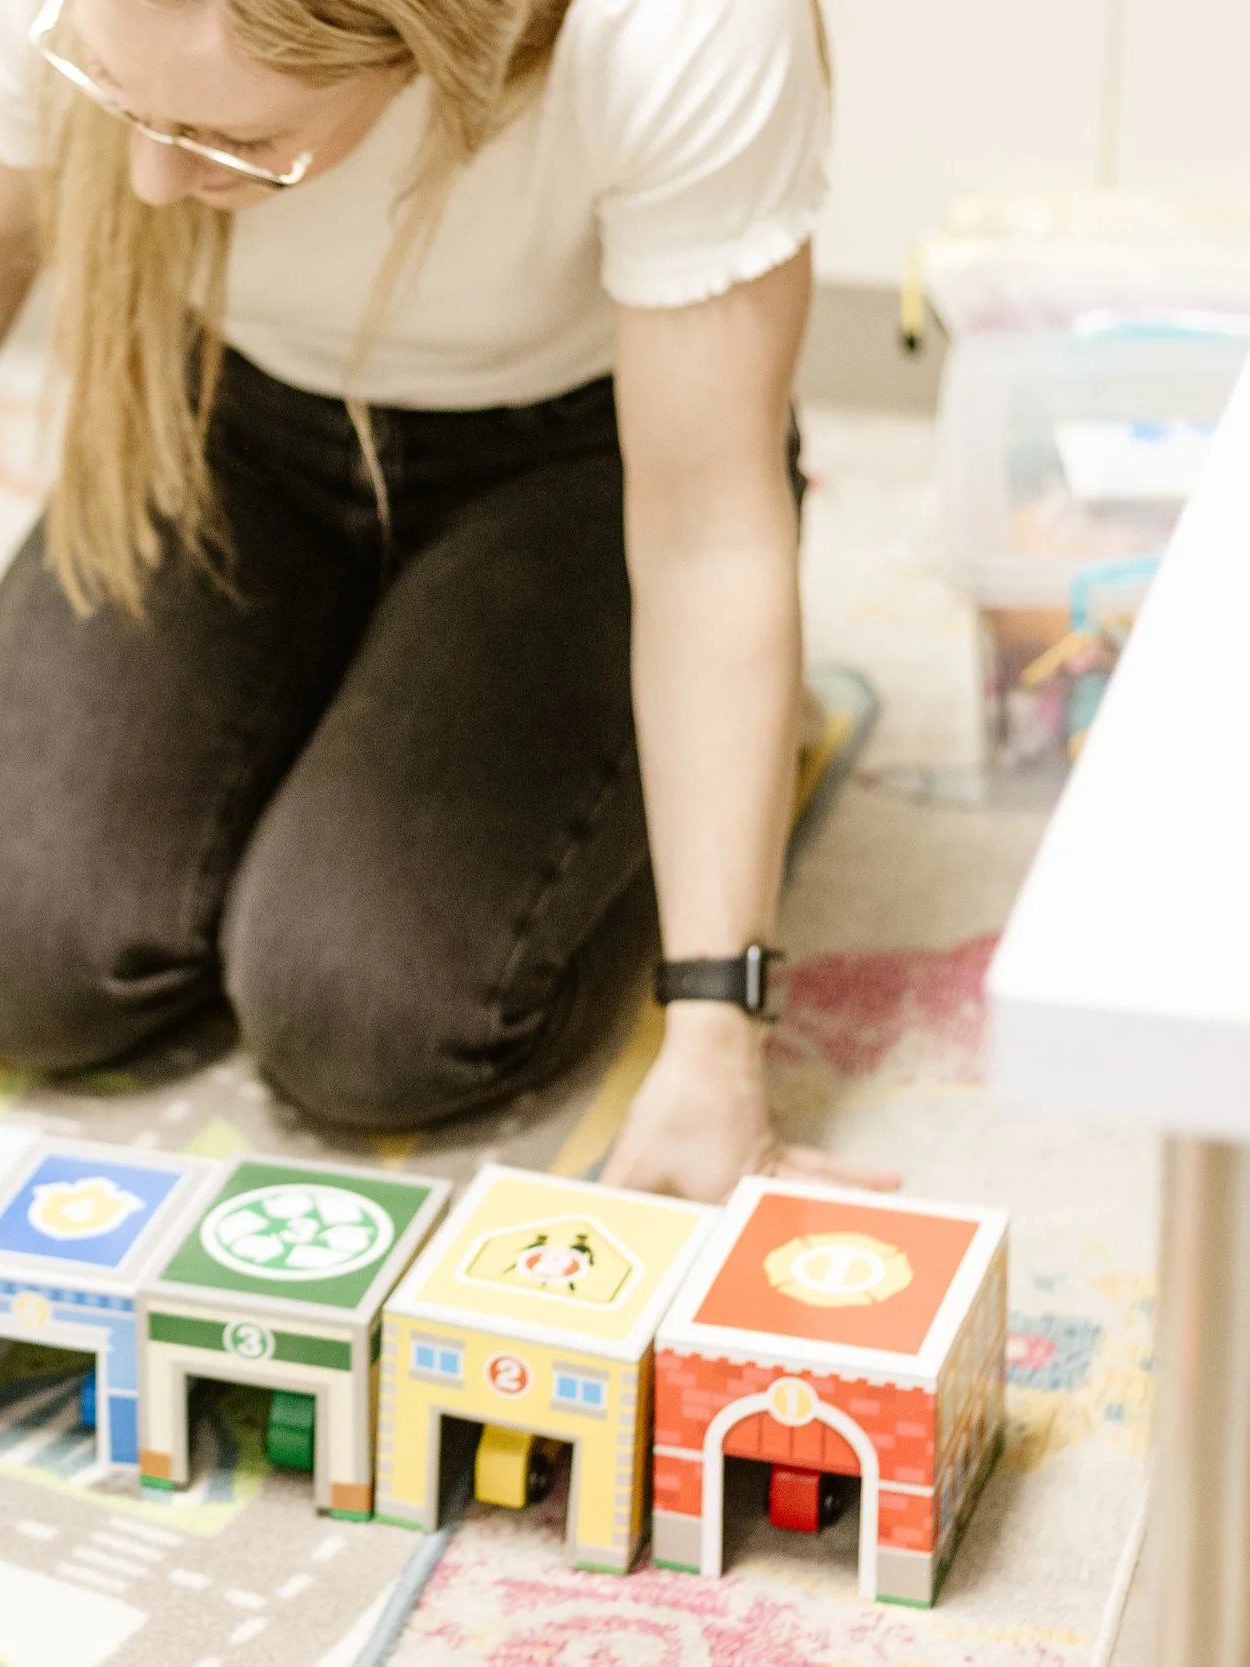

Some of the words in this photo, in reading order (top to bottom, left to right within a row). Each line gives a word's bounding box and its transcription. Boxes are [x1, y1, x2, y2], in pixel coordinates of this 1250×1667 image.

[236, 1326, 262, 1355] 3
[497, 1360, 521, 1388] 2
[781, 1386, 798, 1417] 1
